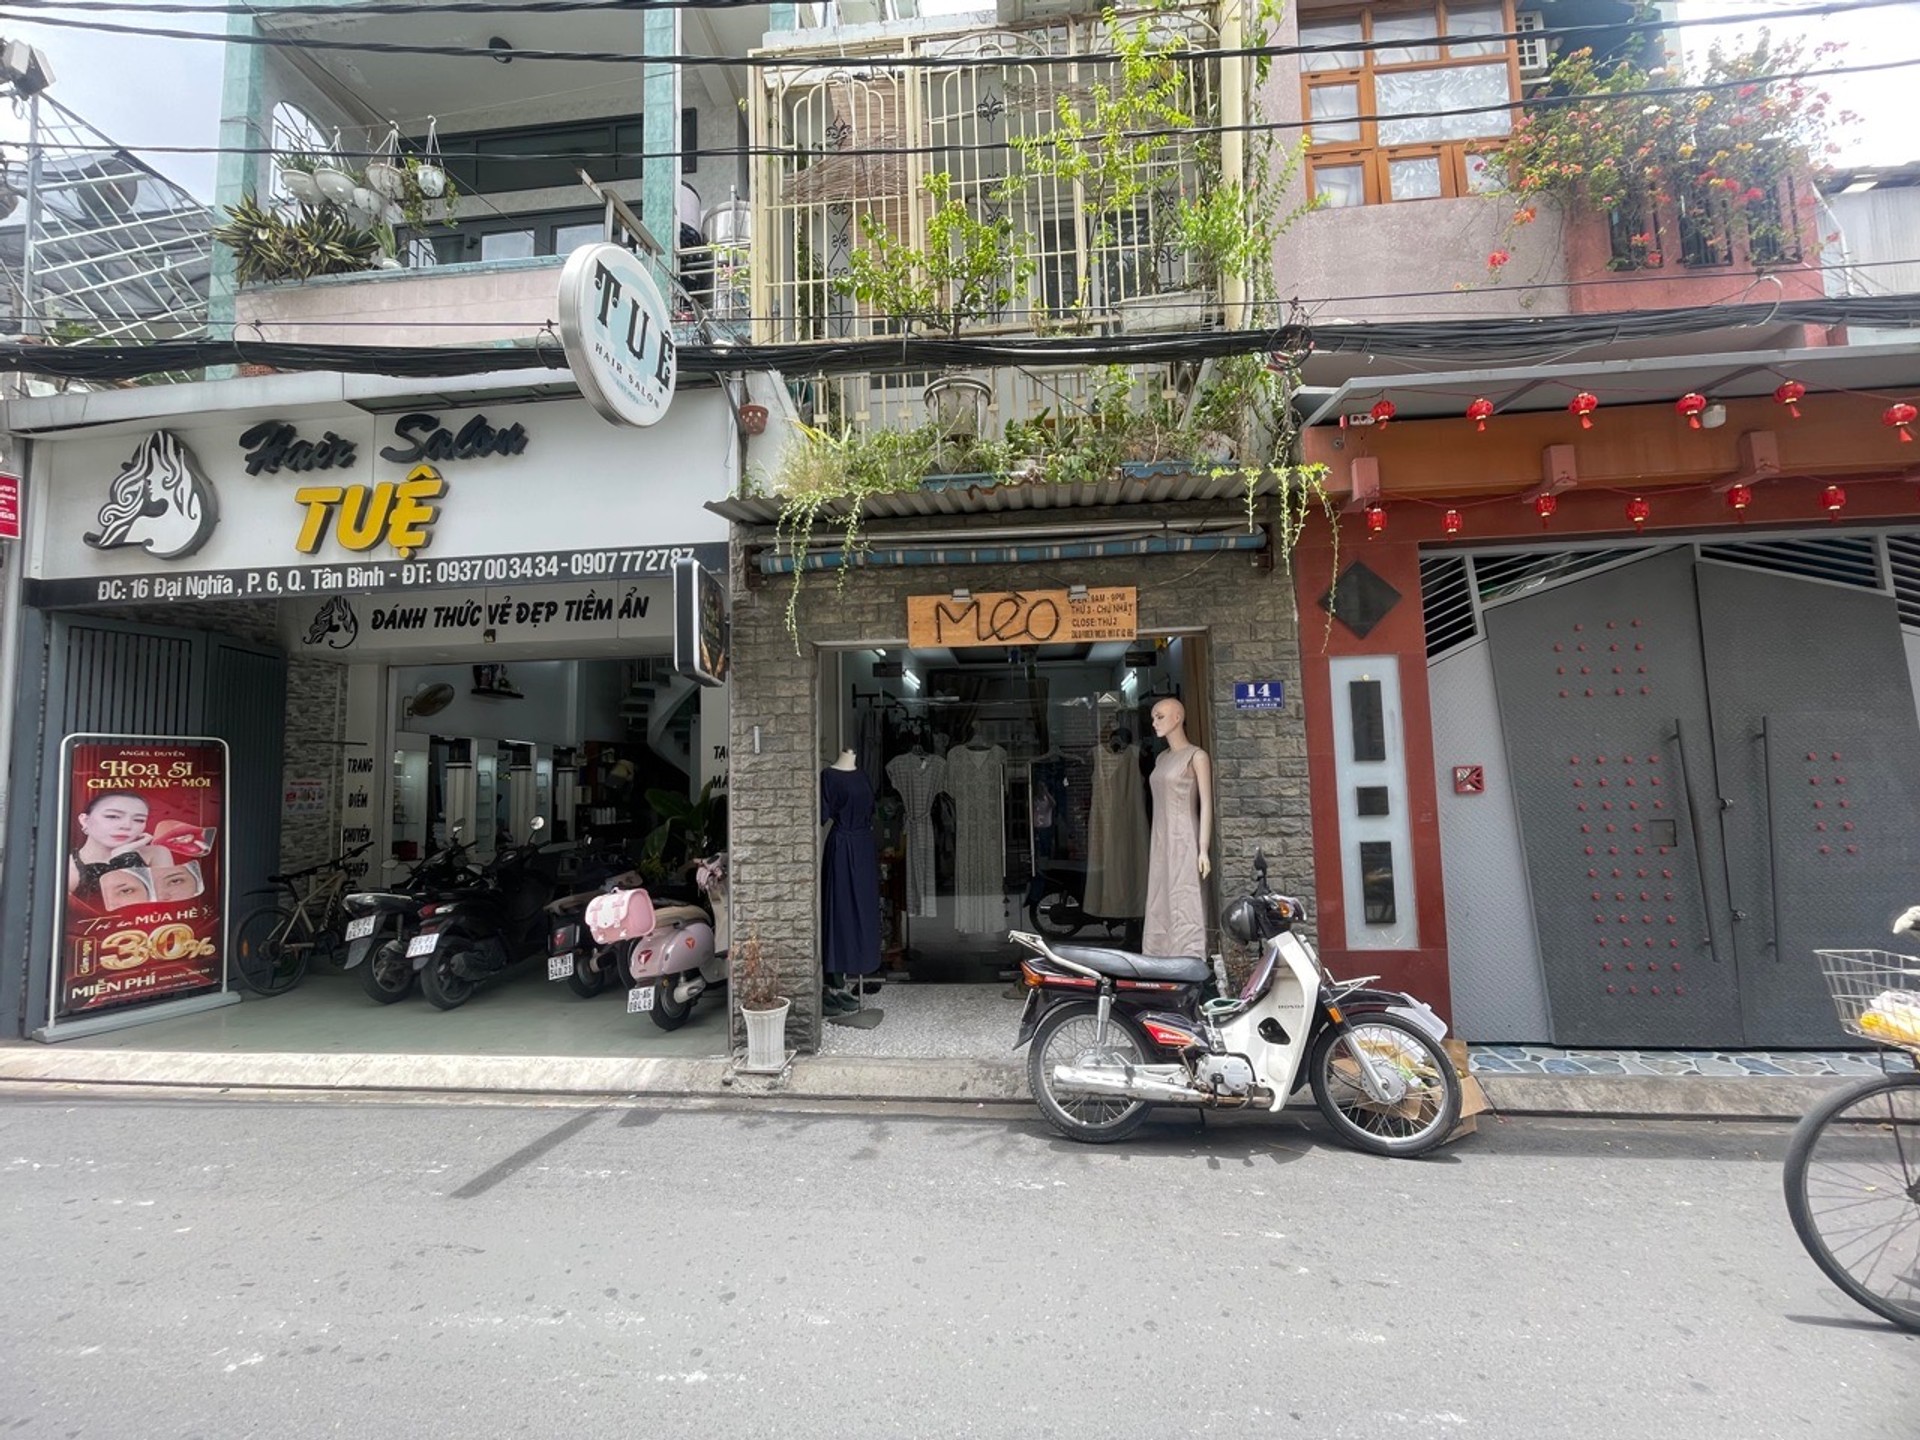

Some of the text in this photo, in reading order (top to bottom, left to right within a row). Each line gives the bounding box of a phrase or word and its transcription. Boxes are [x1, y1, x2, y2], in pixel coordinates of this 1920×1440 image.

[595, 342, 624, 376] HAIR
[628, 374, 660, 410] SALON
[239, 413, 530, 476] Hair Salon
[294, 464, 449, 560] TUỆ
[98, 580, 128, 601] ĐC:
[130, 578, 150, 599] 16
[153, 577, 182, 601] Đại
[247, 572, 262, 593] P.
[266, 571, 283, 596] 6,
[287, 569, 306, 592] Q.
[310, 567, 343, 590] Tân
[346, 565, 385, 588] Bình
[402, 563, 432, 585] ĐT:
[371, 586, 650, 631] ĐÁNH THỨC VẺ ĐẸP TIỀM ẨN
[1247, 683, 1270, 698] 14
[87, 776, 136, 789] CHÂN
[181, 776, 211, 788] MÔI
[347, 757, 374, 774] TRANG
[135, 910, 173, 926] MÙA
[176, 907, 199, 920] HÈ
[99, 923, 216, 970] 30%
[71, 979, 121, 999] MIỄN
[125, 971, 156, 990] PHÍ
